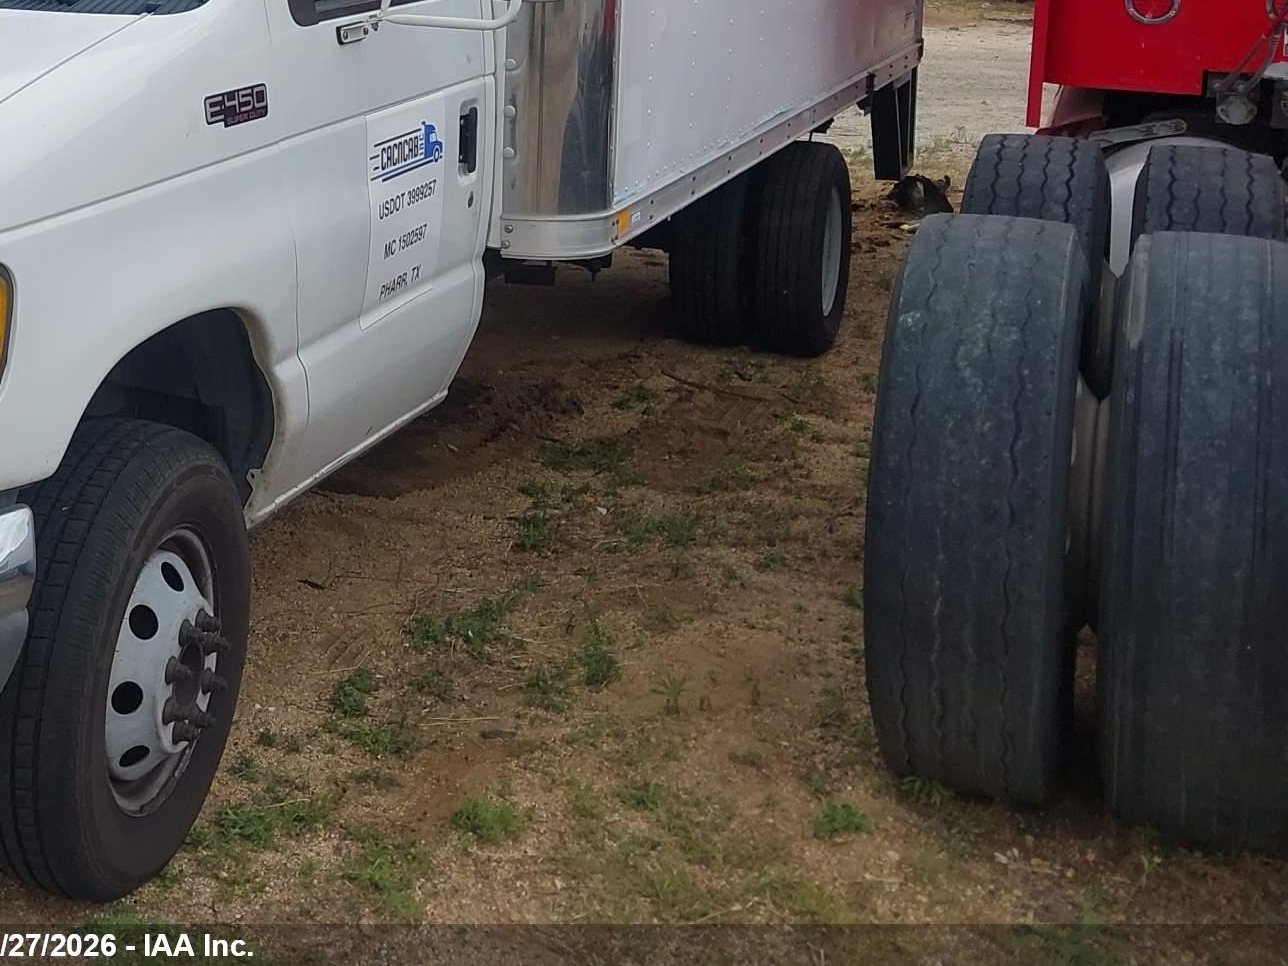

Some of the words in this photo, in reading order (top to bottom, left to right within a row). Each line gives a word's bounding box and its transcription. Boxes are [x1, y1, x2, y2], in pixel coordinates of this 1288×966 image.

[205, 85, 267, 123] E-450
[378, 192, 406, 220] USDOT
[407, 179, 437, 206] 3999257
[383, 239, 397, 260] MC
[398, 223, 428, 252] 1502597
[411, 263, 422, 283] TX
